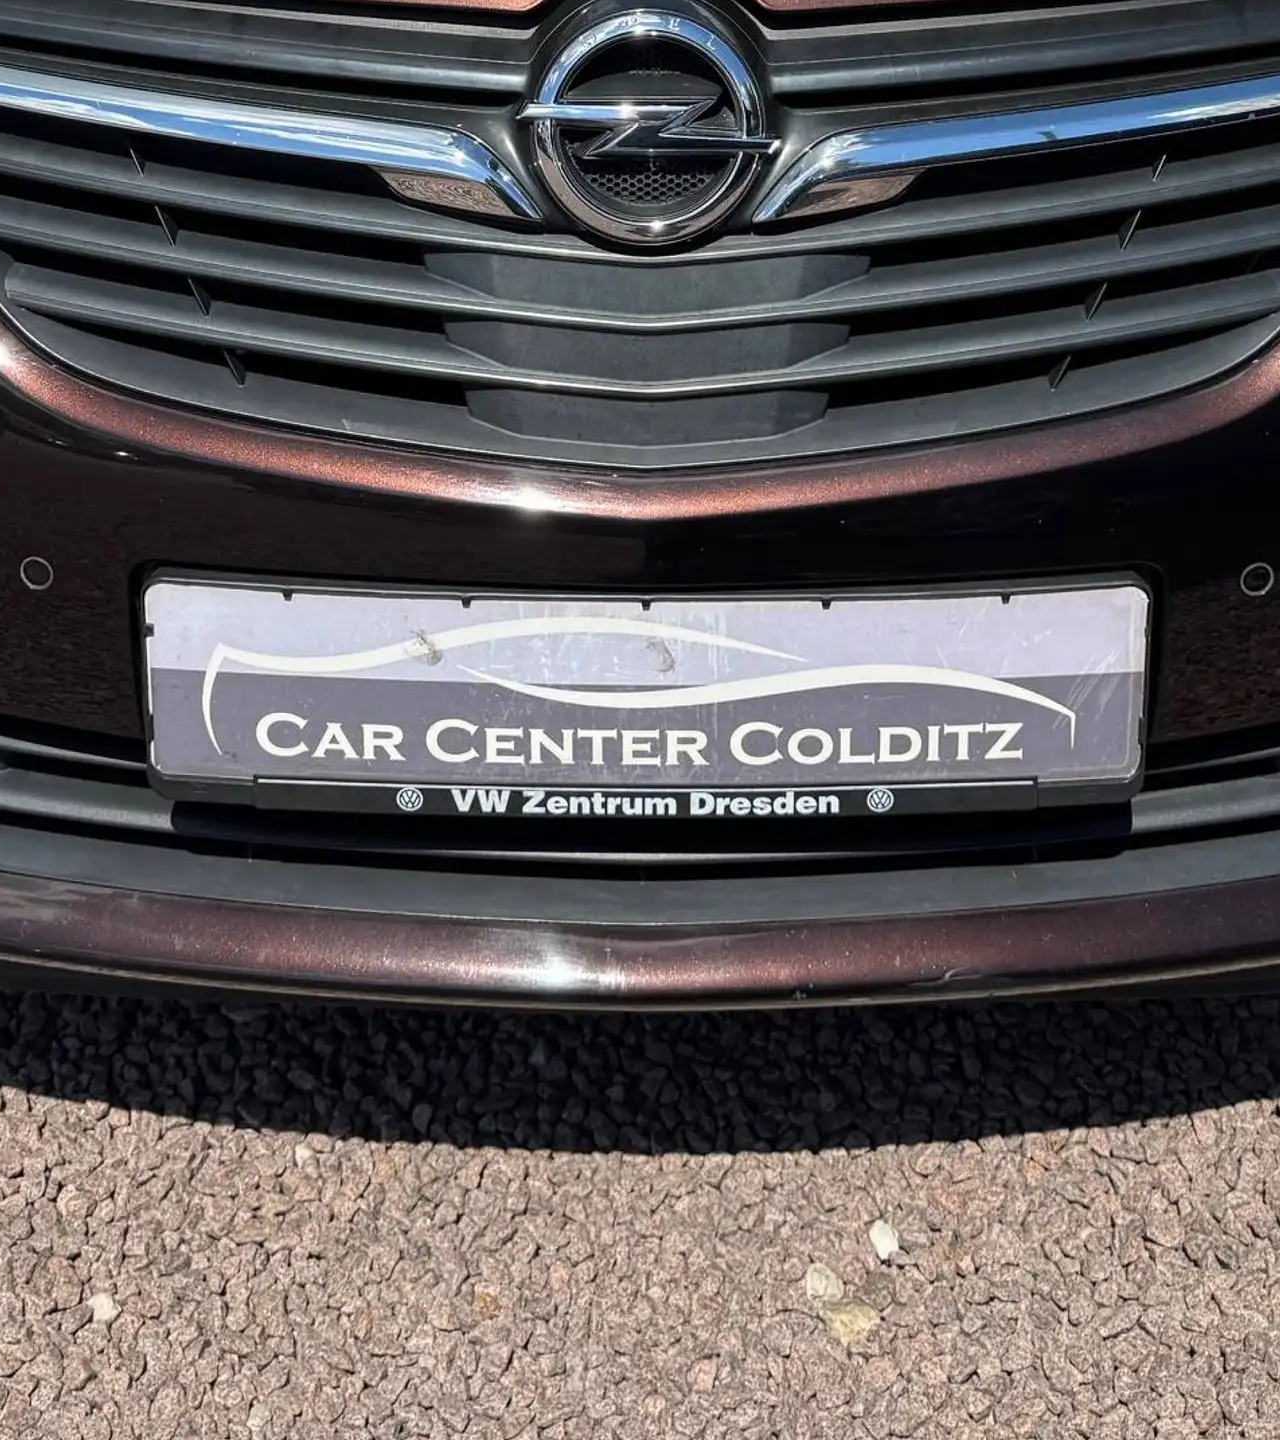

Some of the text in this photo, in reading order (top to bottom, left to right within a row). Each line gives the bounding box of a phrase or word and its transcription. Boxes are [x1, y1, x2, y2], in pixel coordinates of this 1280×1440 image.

[255, 712, 1024, 767] CAR CENTER COLDITZ
[450, 787, 840, 817] VW Zentrum Dresden
